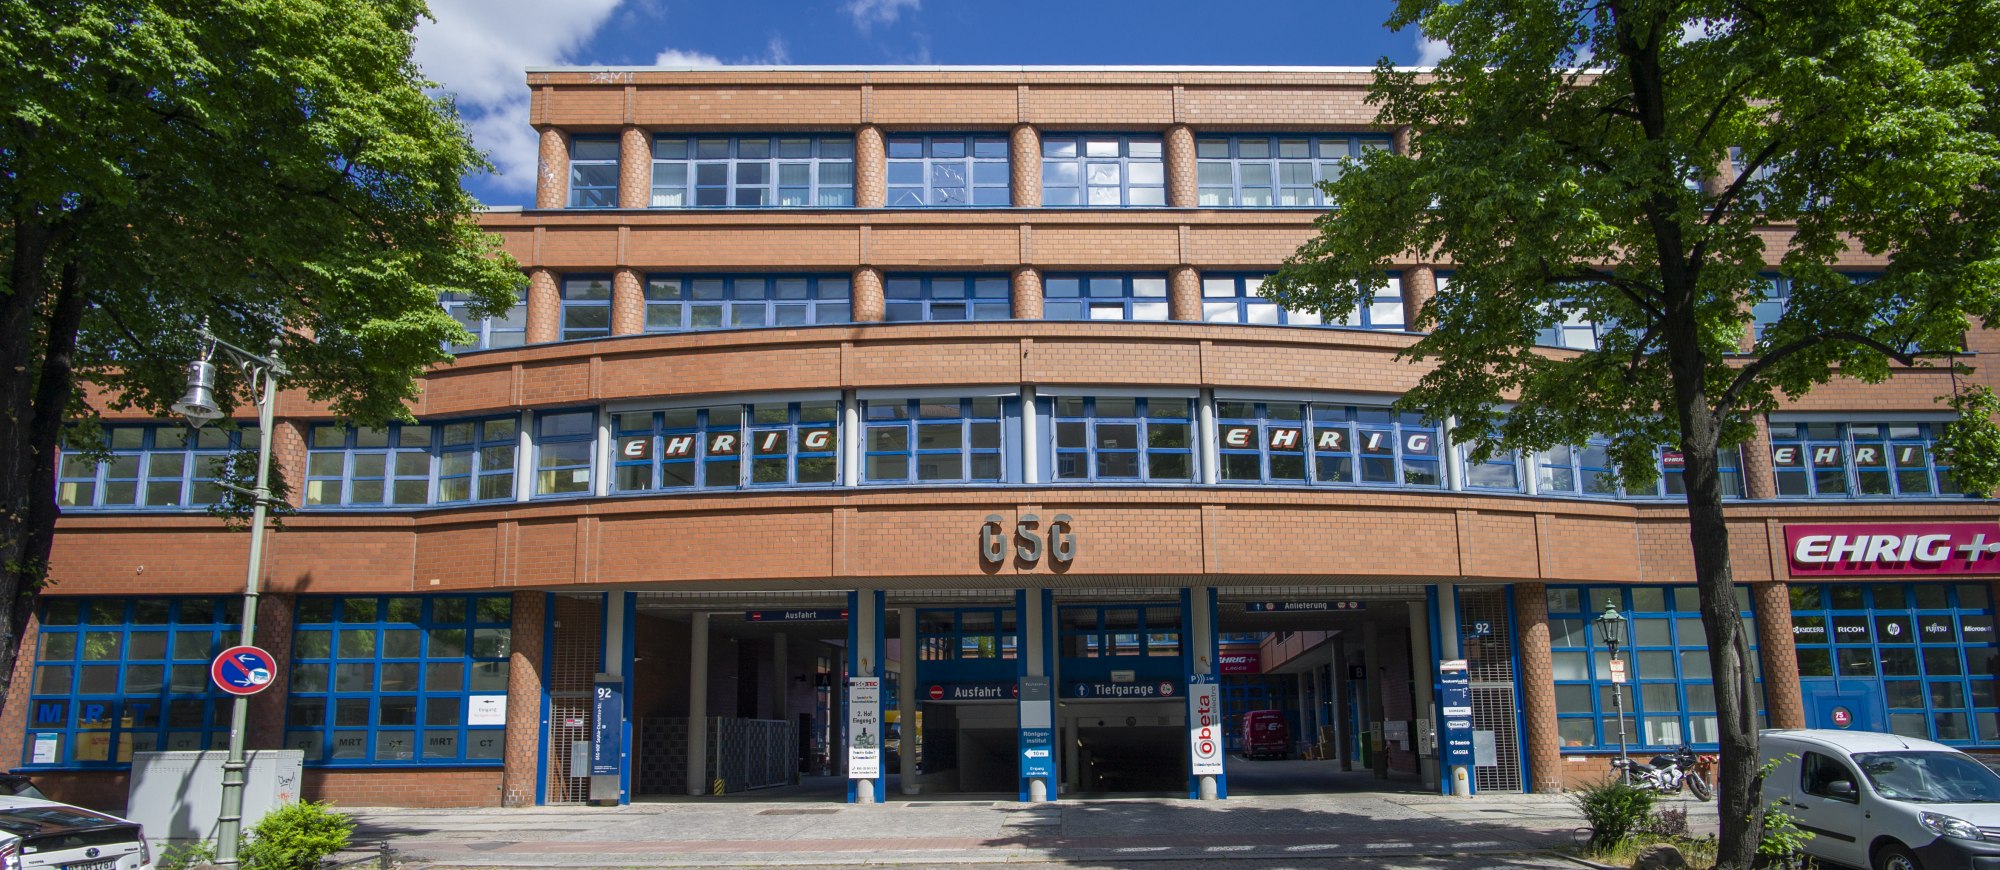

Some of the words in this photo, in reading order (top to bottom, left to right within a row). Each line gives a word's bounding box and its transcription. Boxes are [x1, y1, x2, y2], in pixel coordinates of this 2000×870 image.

[624, 430, 832, 458] EHRIG
[1226, 428, 1429, 453] EHRIG
[1775, 447, 1953, 465] EHRI
[983, 513, 1076, 562] GSG
[1795, 533, 1951, 563] EHRIG
[1284, 602, 1327, 610] Anlieferung
[785, 611, 816, 619] Ausfahrt
[1475, 622, 1489, 633] 92
[1925, 623, 1947, 634] FUJITSU
[597, 687, 612, 698] 92
[955, 686, 1002, 697] Ausfahrt
[1094, 684, 1153, 696] Tiefgarage
[37, 704, 151, 723] MRT
[1198, 695, 1213, 754] obeta
[339, 738, 362, 746] MRT
[430, 738, 453, 746] MRT
[480, 740, 494, 748] CT
